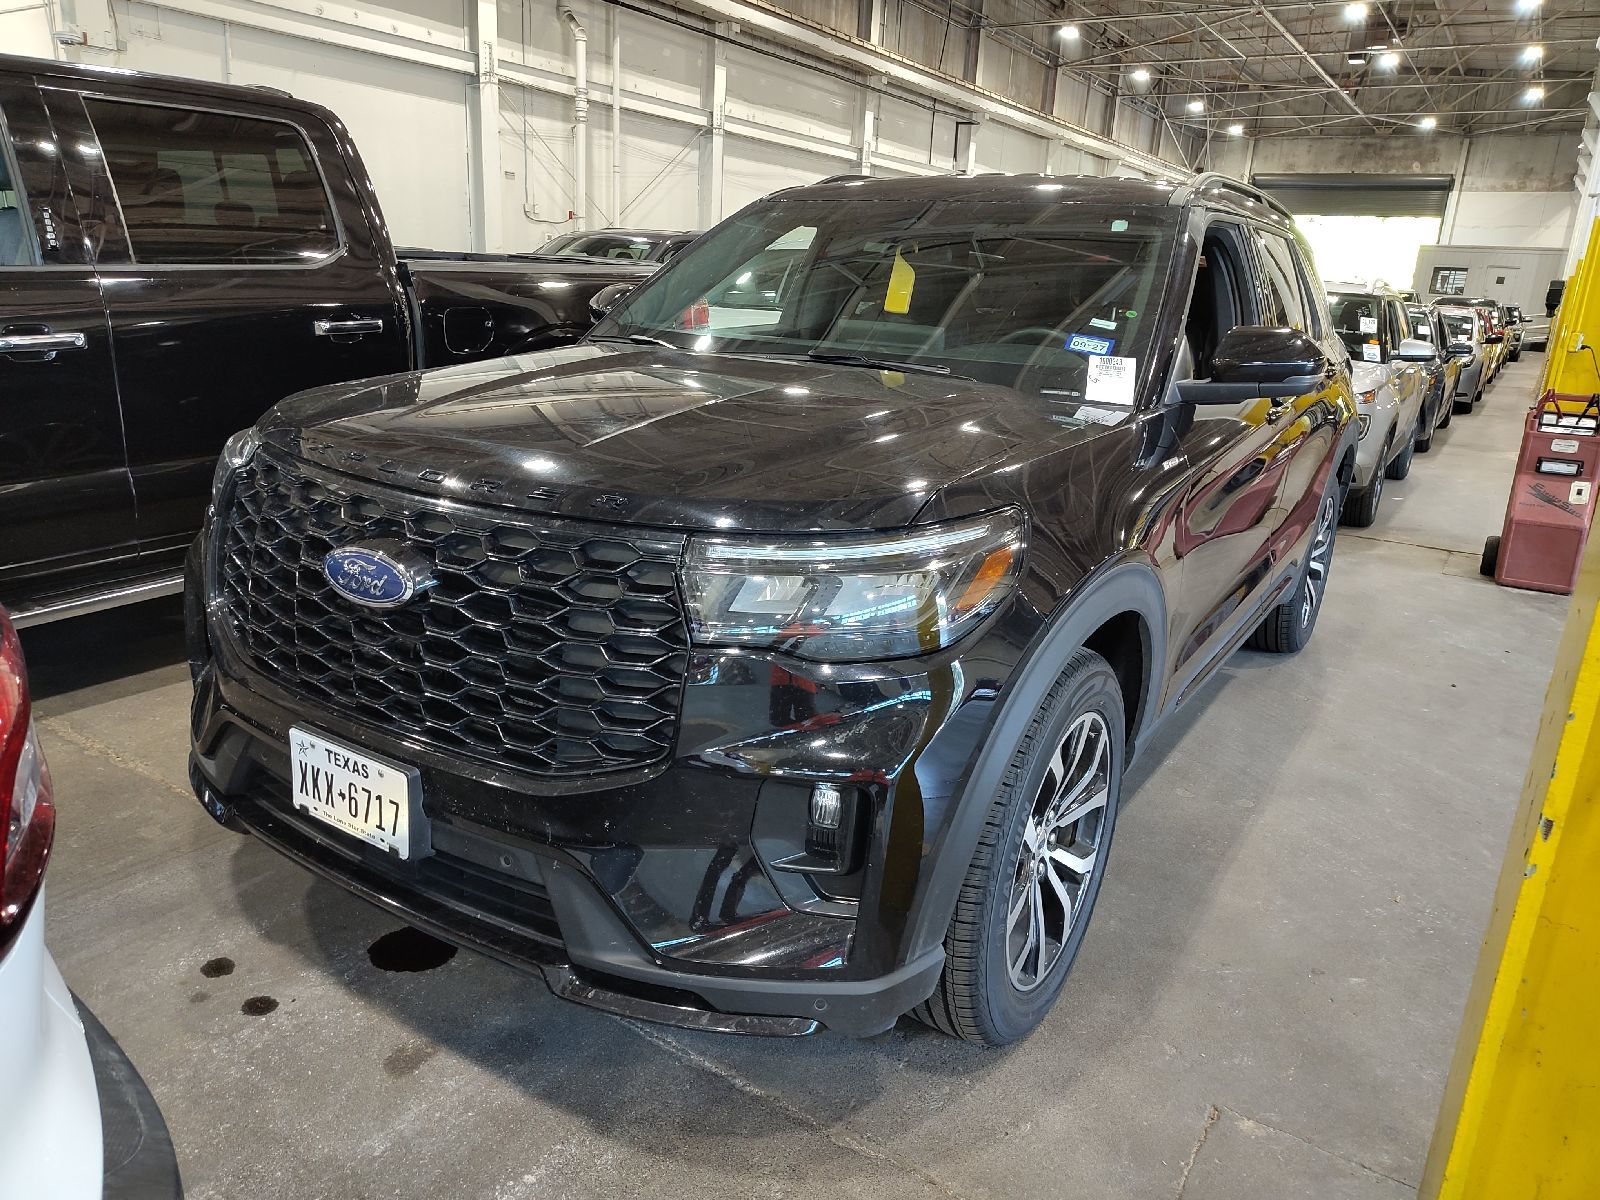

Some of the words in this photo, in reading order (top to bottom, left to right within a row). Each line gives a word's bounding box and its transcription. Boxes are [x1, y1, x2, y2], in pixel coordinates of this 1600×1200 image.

[338, 558, 387, 596] Ford
[325, 749, 369, 779] TEXAS
[323, 810, 332, 819] The
